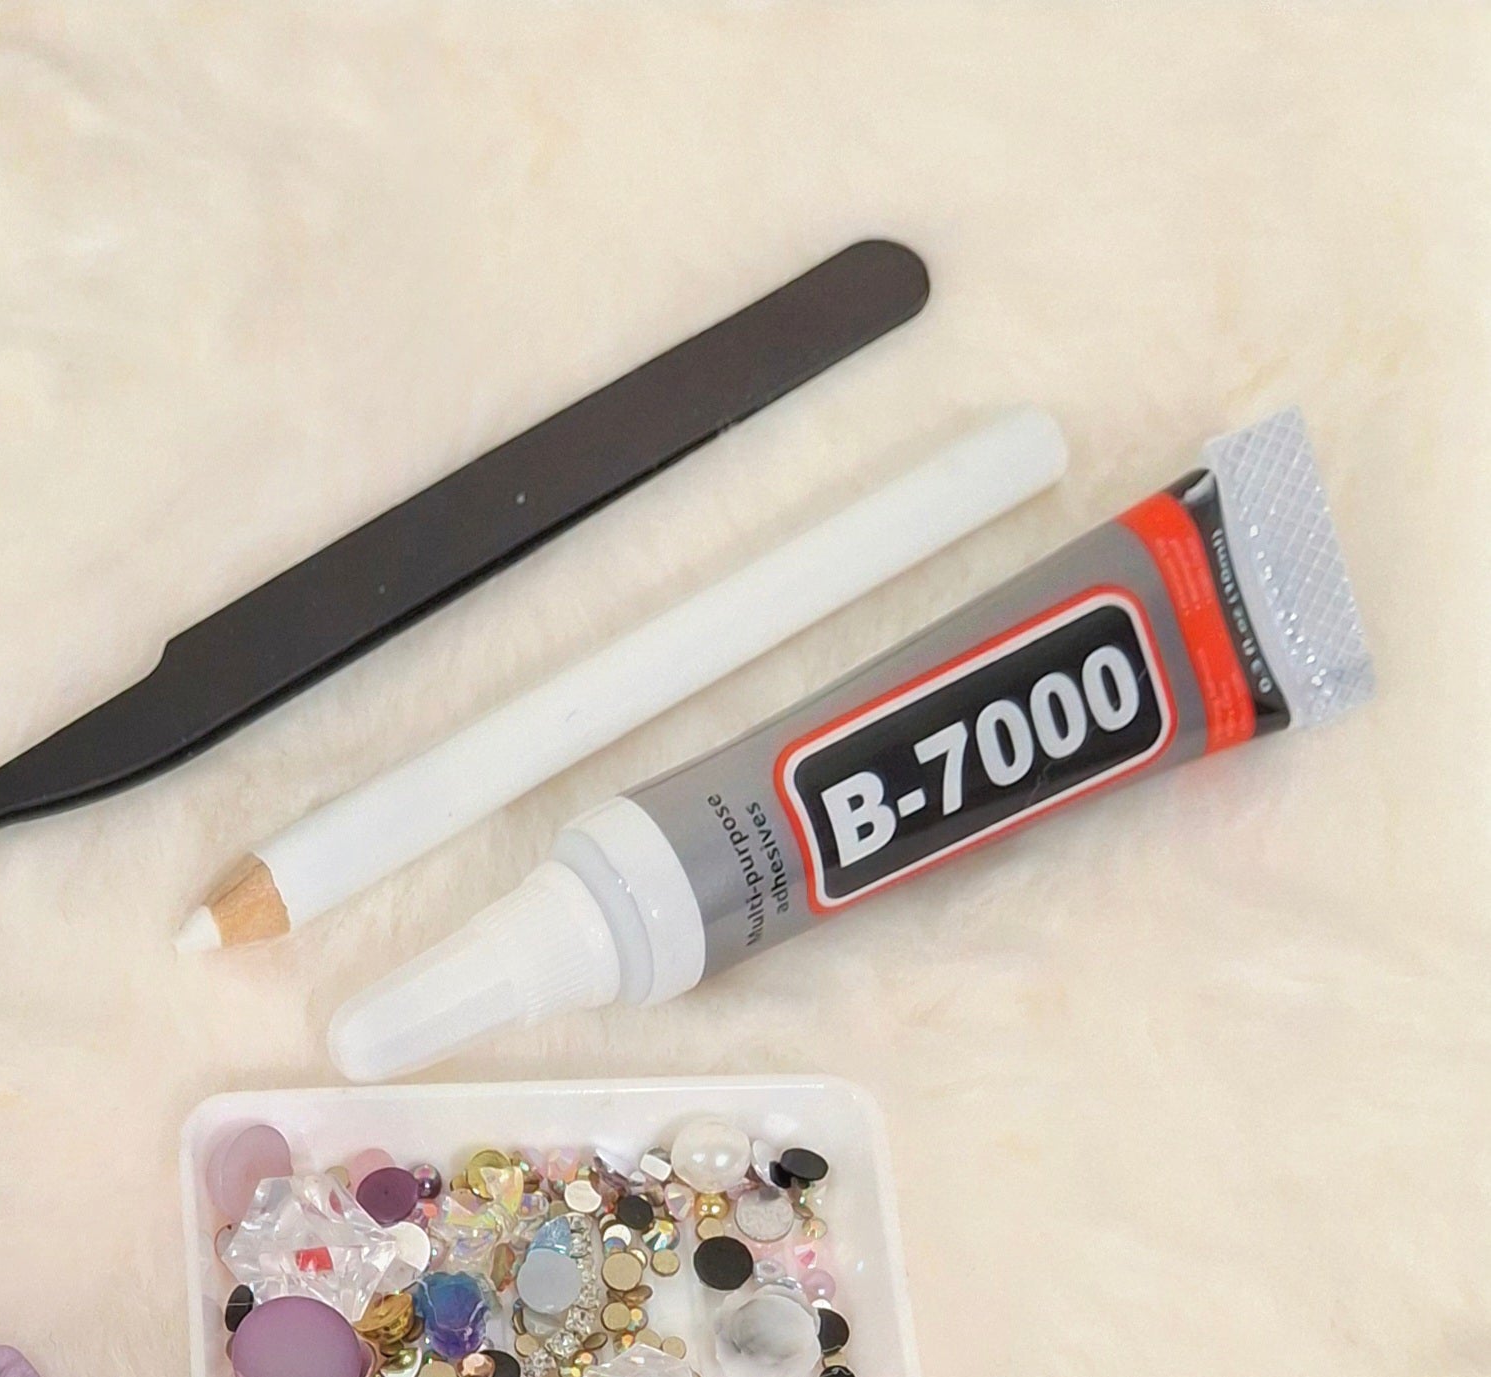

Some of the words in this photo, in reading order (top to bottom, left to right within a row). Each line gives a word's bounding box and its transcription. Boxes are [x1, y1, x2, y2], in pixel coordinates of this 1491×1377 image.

[820, 643, 1142, 869] B-7000
[707, 793, 765, 946] Multi-purpose
[746, 801, 789, 914] adhesives
